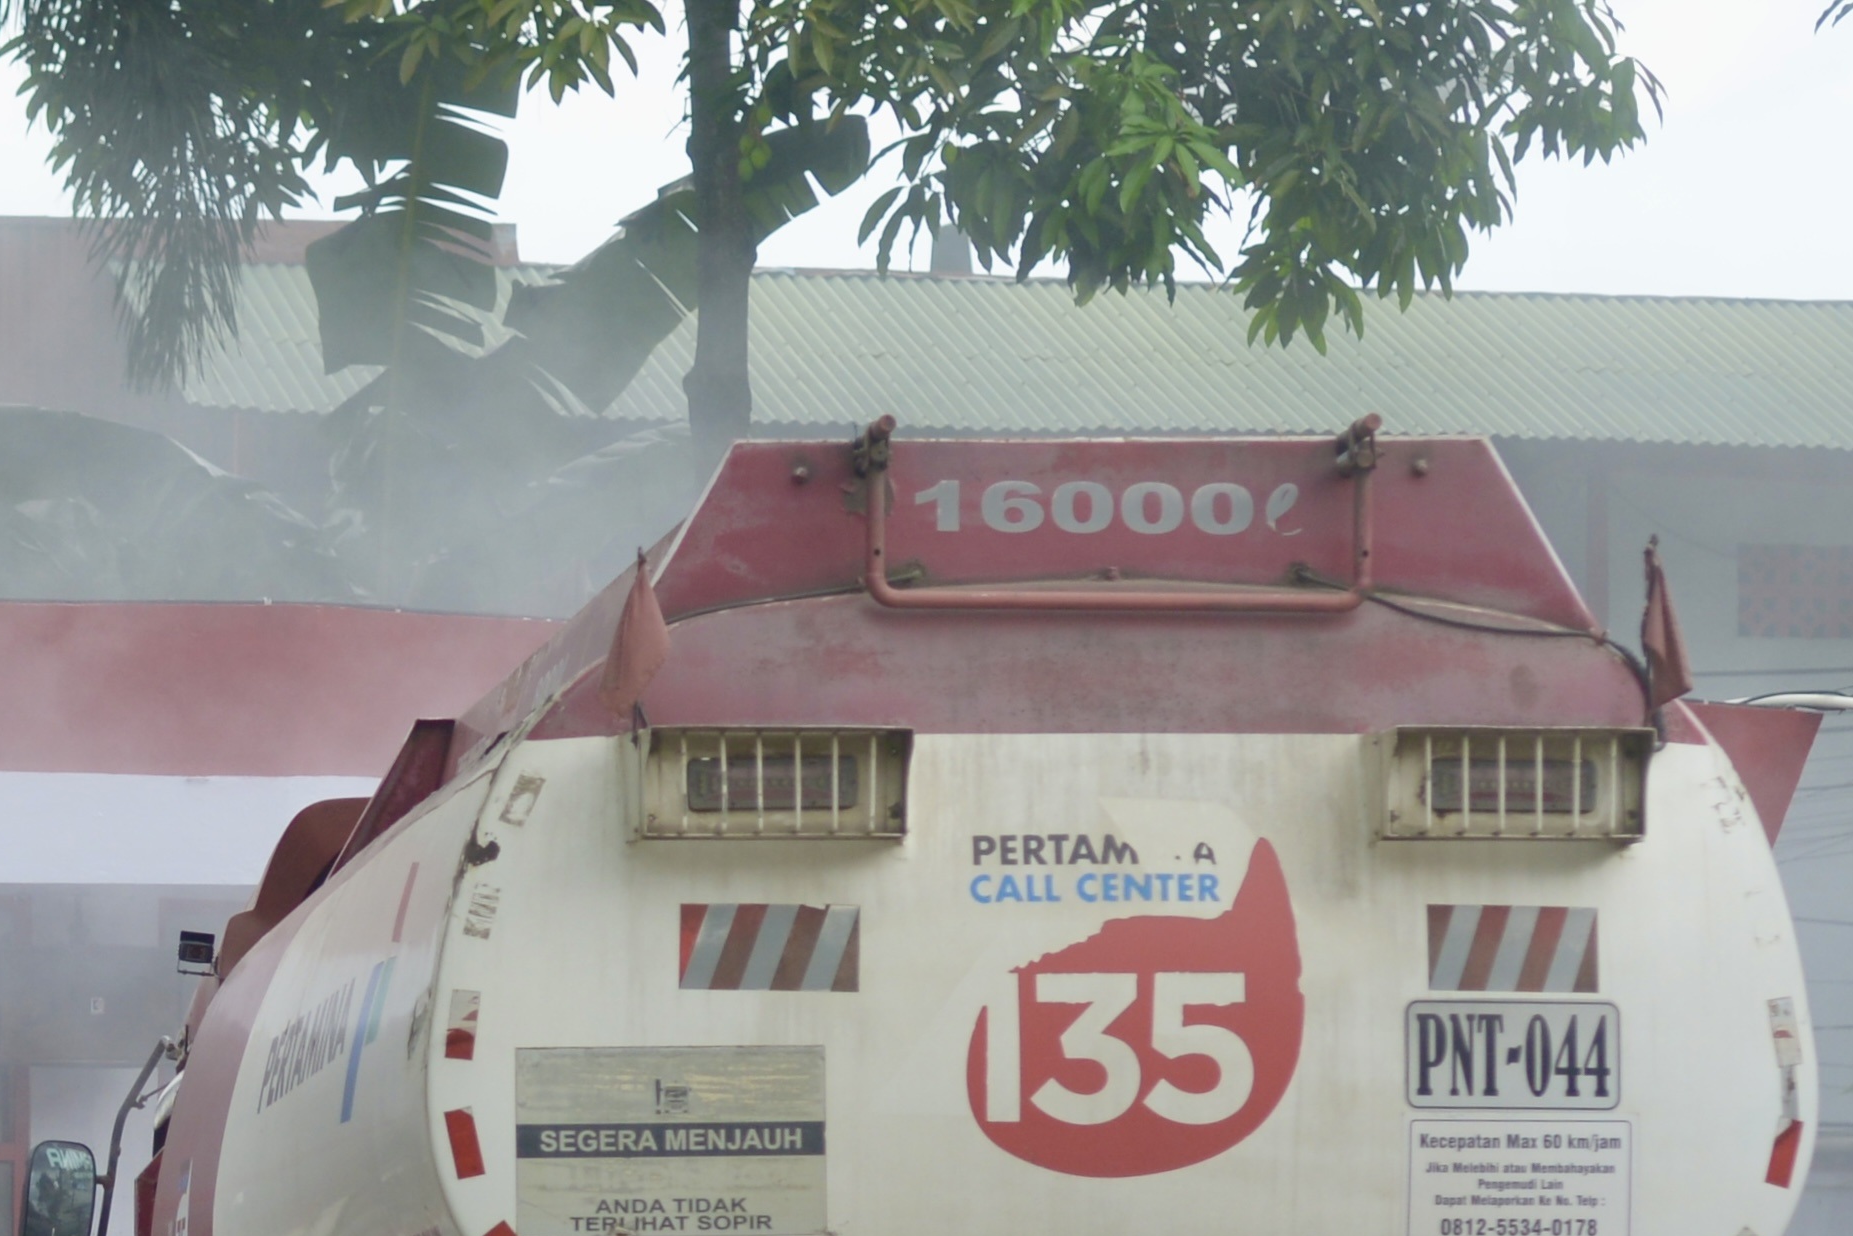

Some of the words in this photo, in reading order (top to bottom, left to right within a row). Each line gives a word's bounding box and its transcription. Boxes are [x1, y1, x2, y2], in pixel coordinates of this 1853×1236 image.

[971, 834, 1217, 866] PERTAMA
[970, 874, 1061, 904] CALL
[1076, 873, 1220, 902] CENTER
[257, 977, 356, 1114] PERTAMINA
[986, 972, 1254, 1125] 135
[1416, 1013, 1611, 1097] PNT-044
[540, 1130, 658, 1152] SEGERA
[665, 1128, 803, 1151] MENJAUH
[1420, 1133, 1500, 1152] Kecepatan
[1506, 1134, 1537, 1149] Max
[1543, 1134, 1562, 1149] 60
[1568, 1134, 1621, 1151] km/jam
[1425, 1162, 1448, 1173] Jika
[1452, 1162, 1499, 1173] Melebihi
[1503, 1163, 1527, 1173] atau
[1531, 1163, 1615, 1175] Membahayakan
[1478, 1179, 1537, 1192] Pengemudi
[1541, 1179, 1563, 1189] Lain
[596, 1199, 665, 1214] ANDA
[672, 1198, 747, 1213] TIDAK
[1435, 1195, 1467, 1207] Dapat
[1471, 1195, 1535, 1207] Melaporkan
[697, 1215, 772, 1230] SOPIR
[1440, 1218, 1597, 1236] 0812-5534-0178
